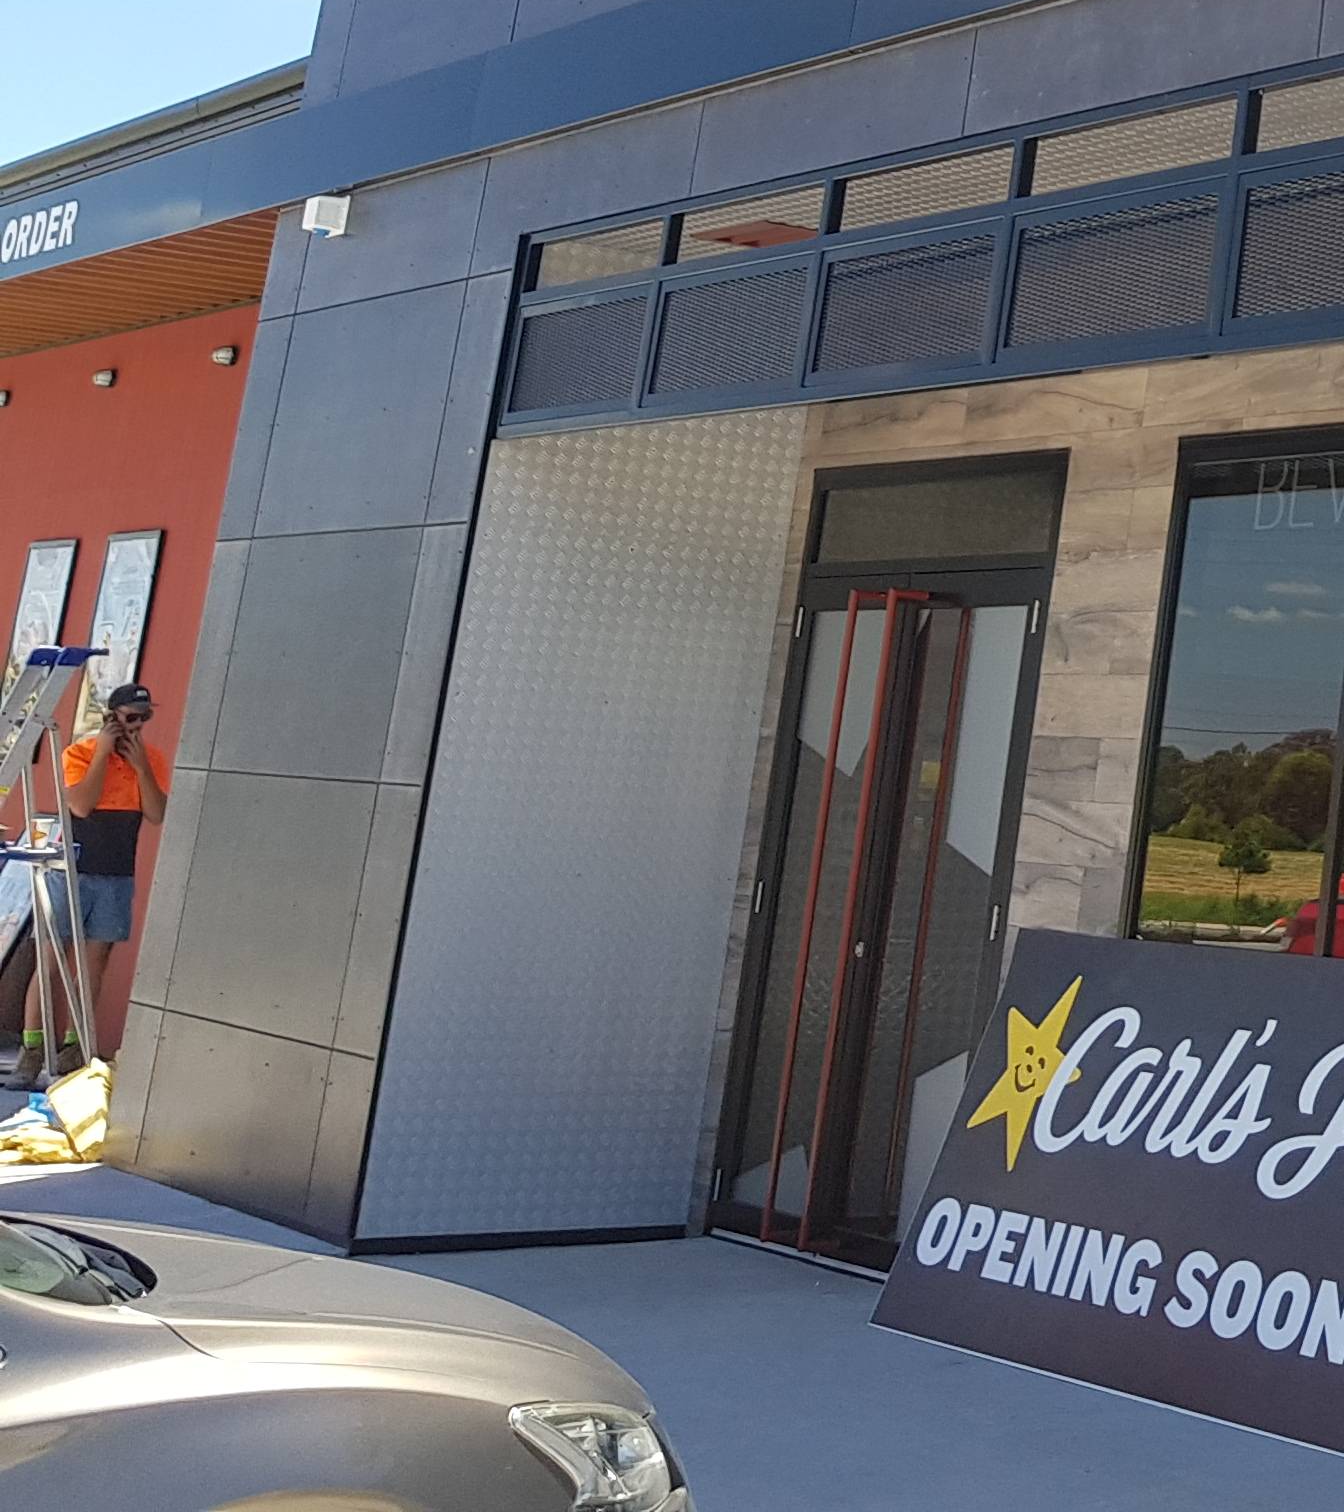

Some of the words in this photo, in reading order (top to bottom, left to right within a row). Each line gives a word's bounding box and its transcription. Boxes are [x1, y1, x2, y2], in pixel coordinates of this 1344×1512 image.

[1, 200, 79, 264] ORDER
[1033, 1006, 1278, 1164] Carl's
[916, 1196, 1162, 1317] OPENING
